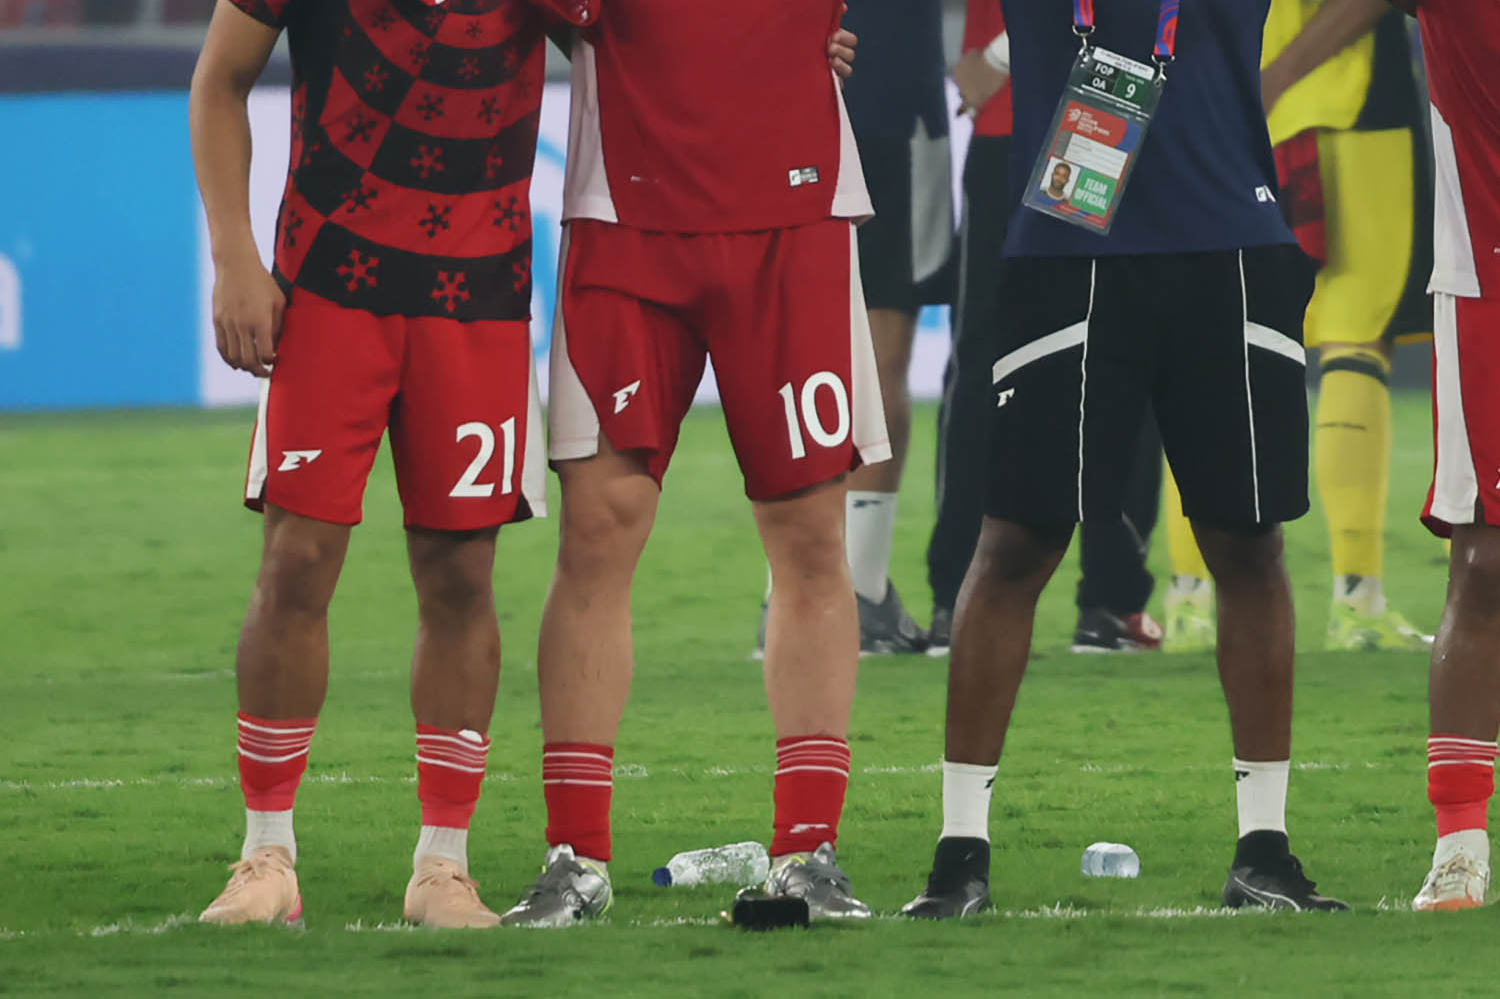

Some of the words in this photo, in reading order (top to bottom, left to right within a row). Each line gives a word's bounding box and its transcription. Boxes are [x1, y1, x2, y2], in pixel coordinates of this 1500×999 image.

[1092, 77, 1107, 90] OA
[1125, 83, 1136, 98] 9
[779, 371, 850, 458] 10
[448, 416, 515, 497] 21
